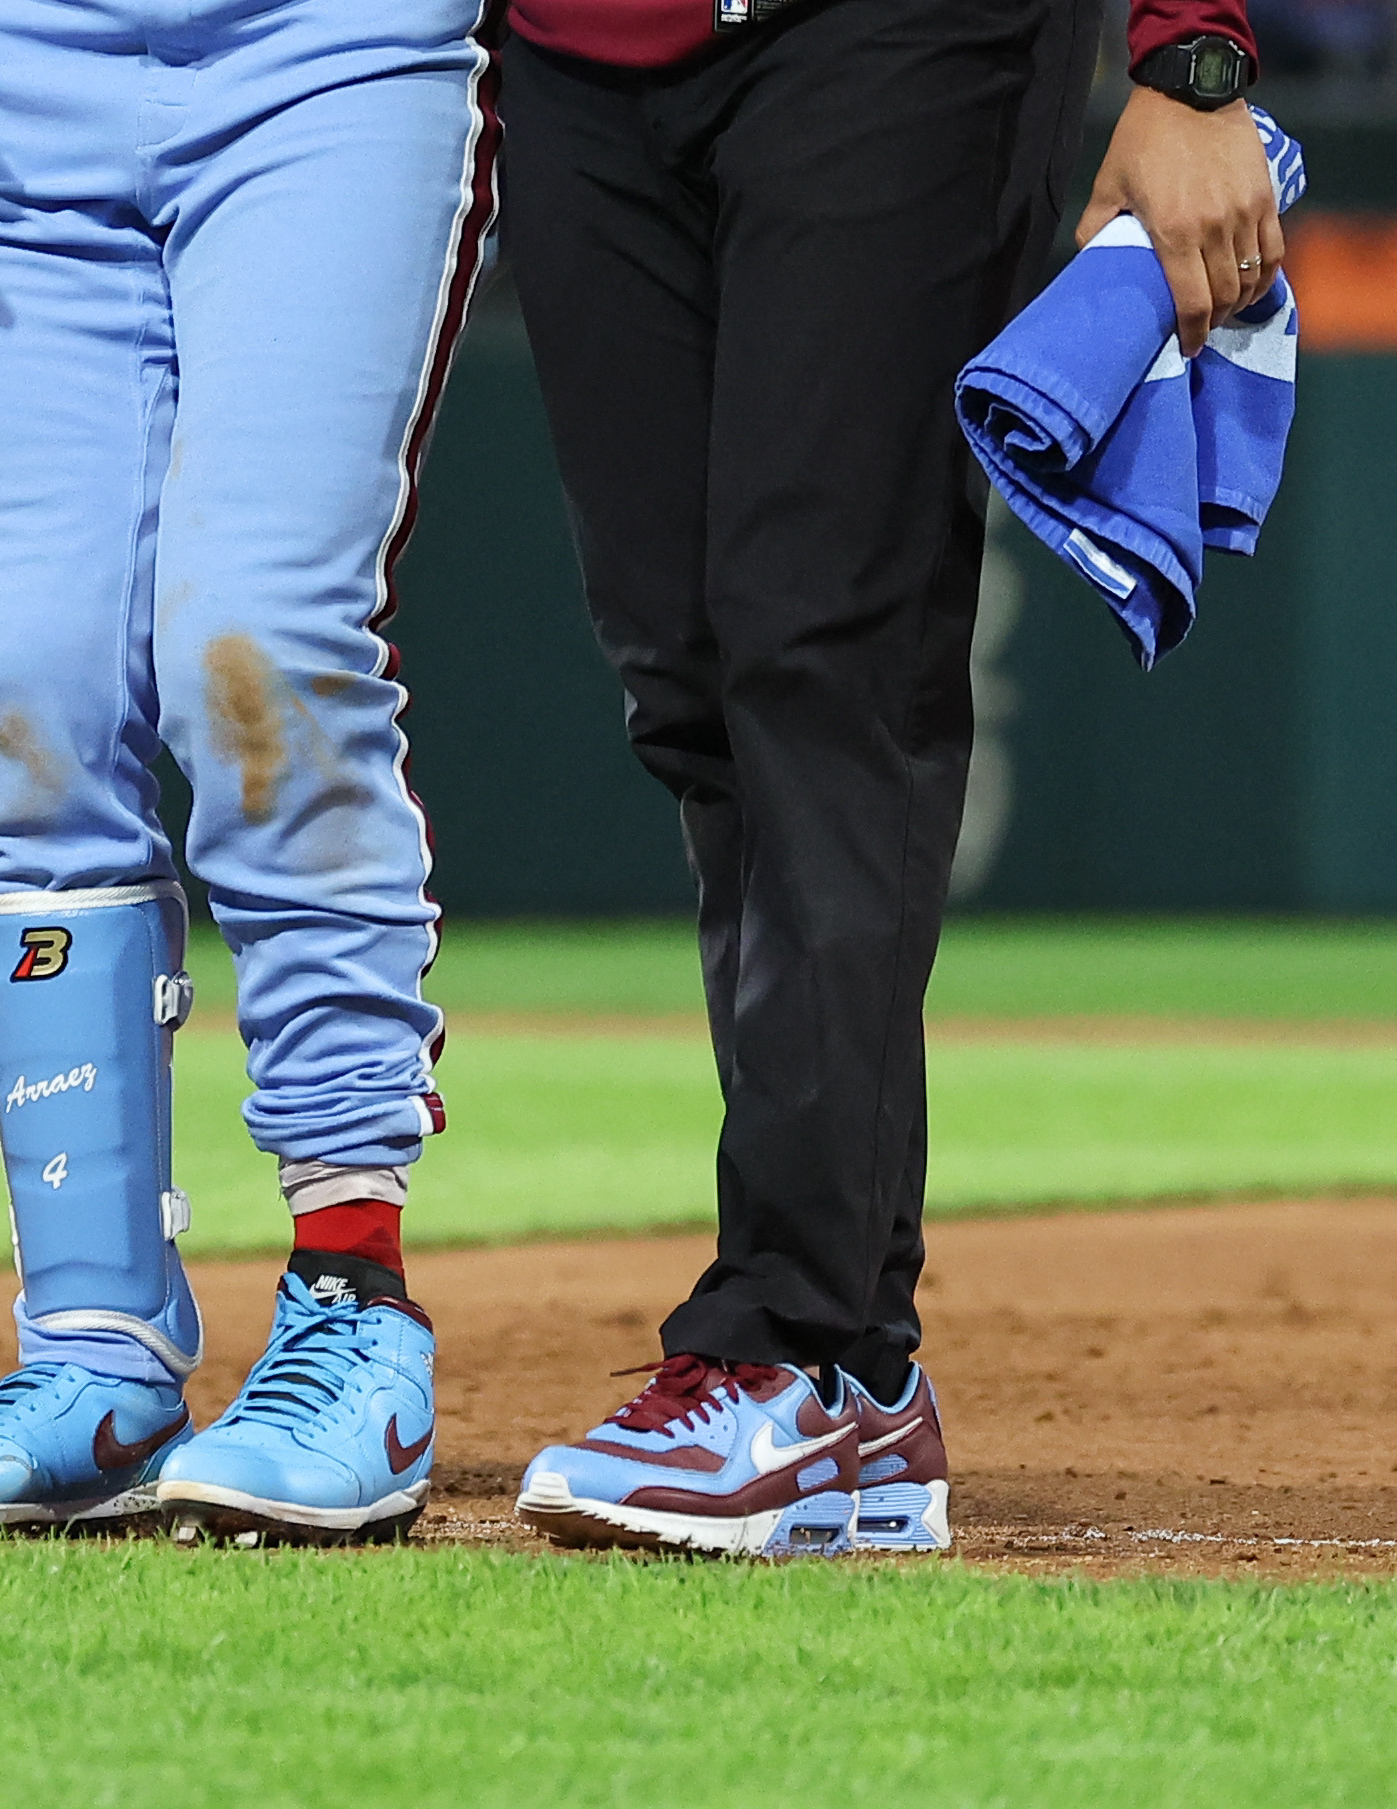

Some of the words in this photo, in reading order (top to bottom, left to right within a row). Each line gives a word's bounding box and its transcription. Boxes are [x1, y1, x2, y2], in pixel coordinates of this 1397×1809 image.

[5, 1062, 97, 1114] Arraez
[42, 1152, 69, 1190] 4
[315, 1274, 349, 1291] NIKE
